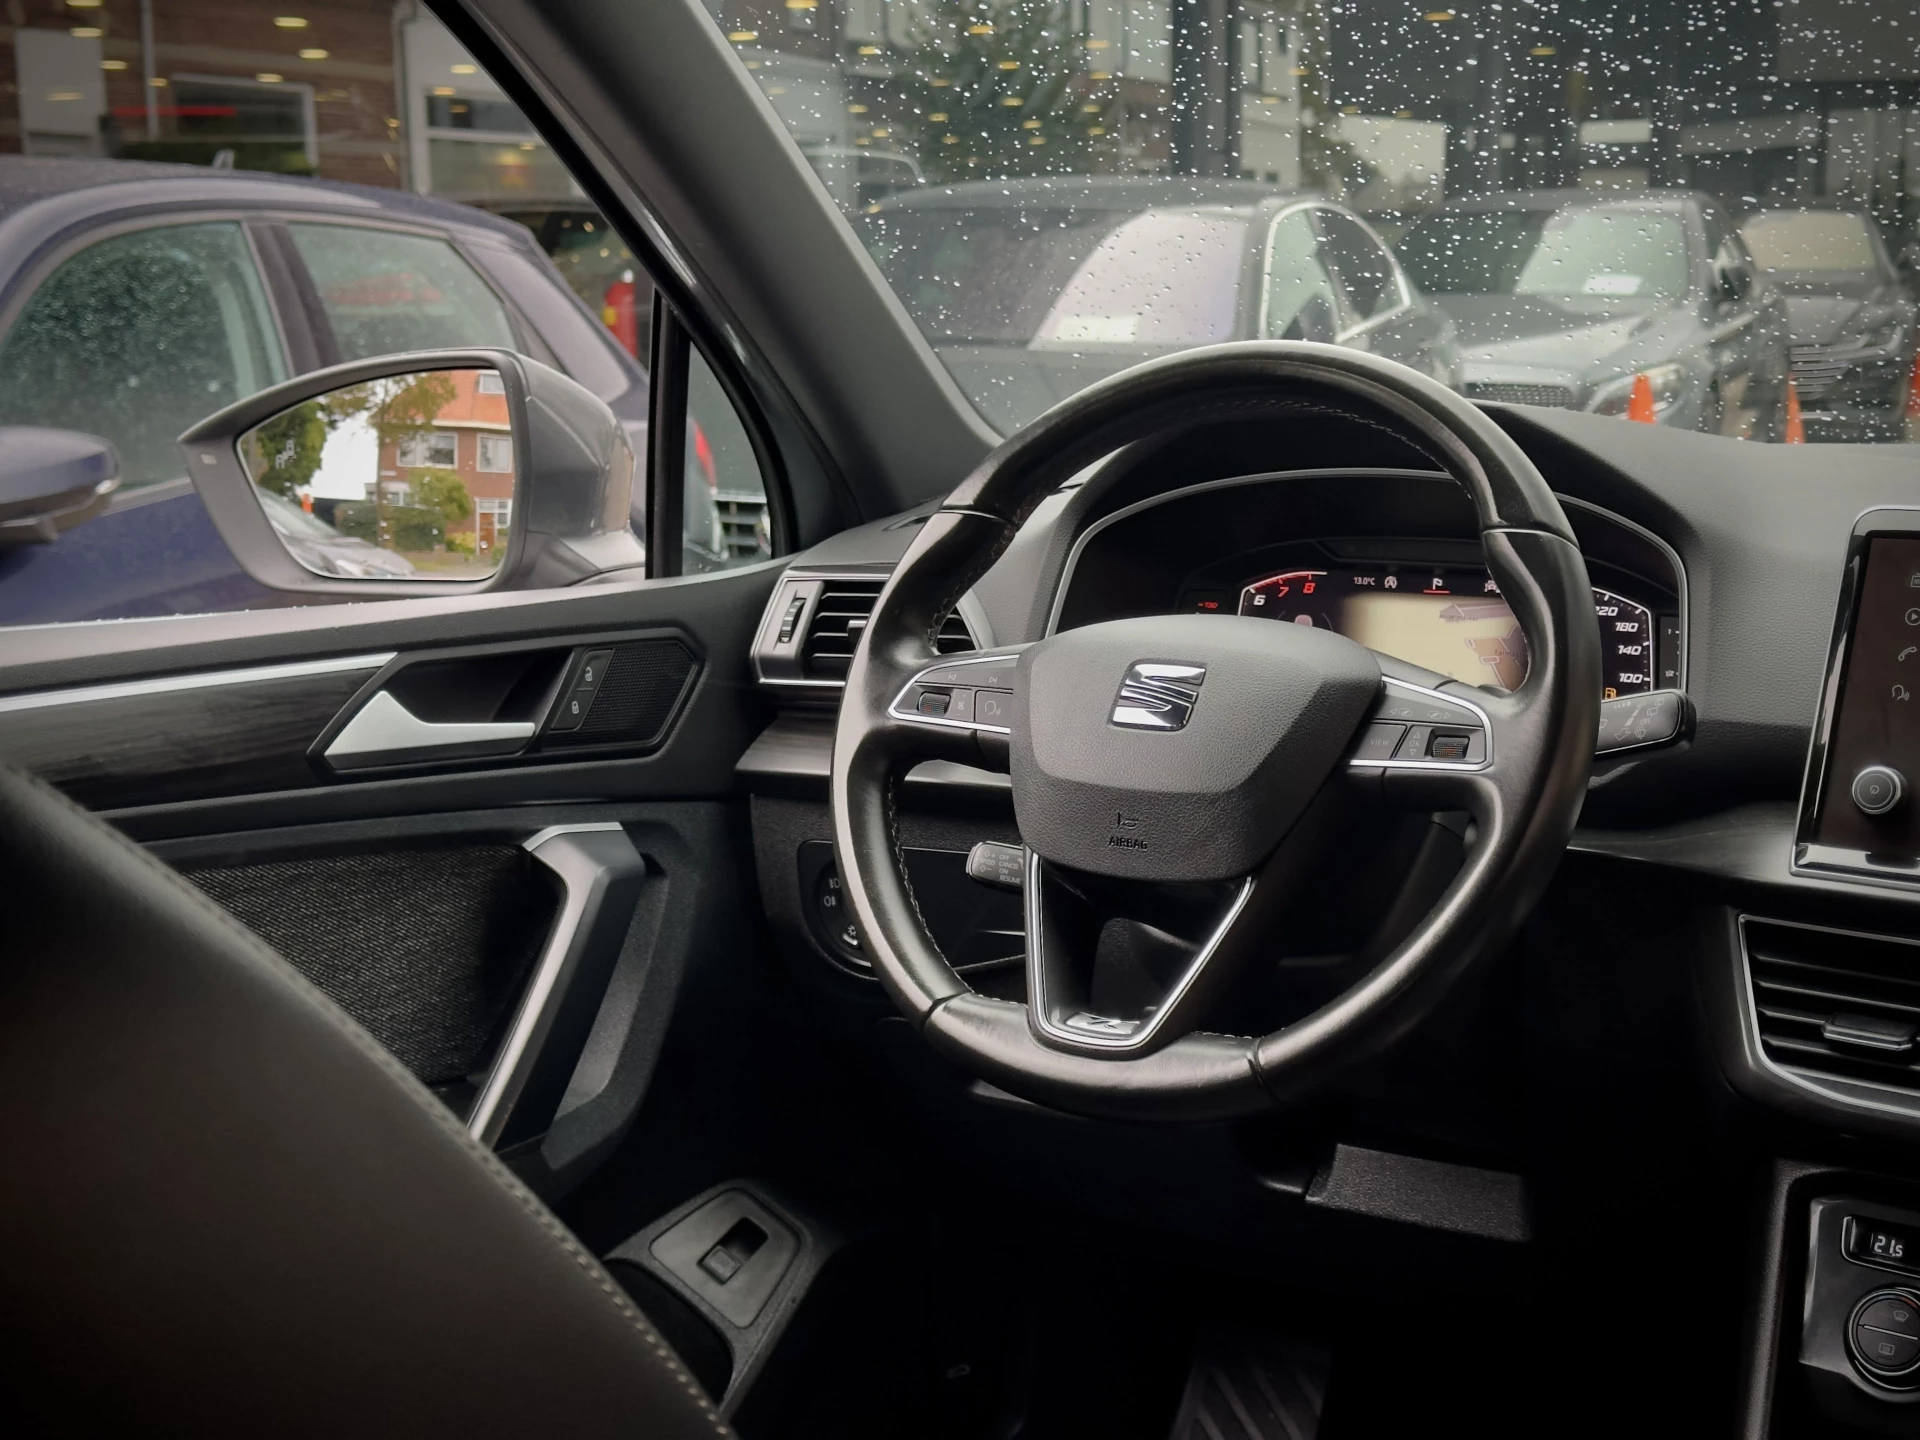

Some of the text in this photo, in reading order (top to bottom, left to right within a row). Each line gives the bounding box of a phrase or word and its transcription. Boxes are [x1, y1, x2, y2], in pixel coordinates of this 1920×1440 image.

[1278, 586, 1289, 598] 7
[1303, 582, 1315, 594] 8
[1253, 595, 1266, 606] 6
[1615, 622, 1638, 632] 180
[1617, 645, 1641, 655] 140
[1618, 673, 1643, 684] 100
[1370, 738, 1389, 746] VIEW
[1108, 836, 1148, 850] AIRBAG
[1873, 1235, 1903, 1257] 21.5
